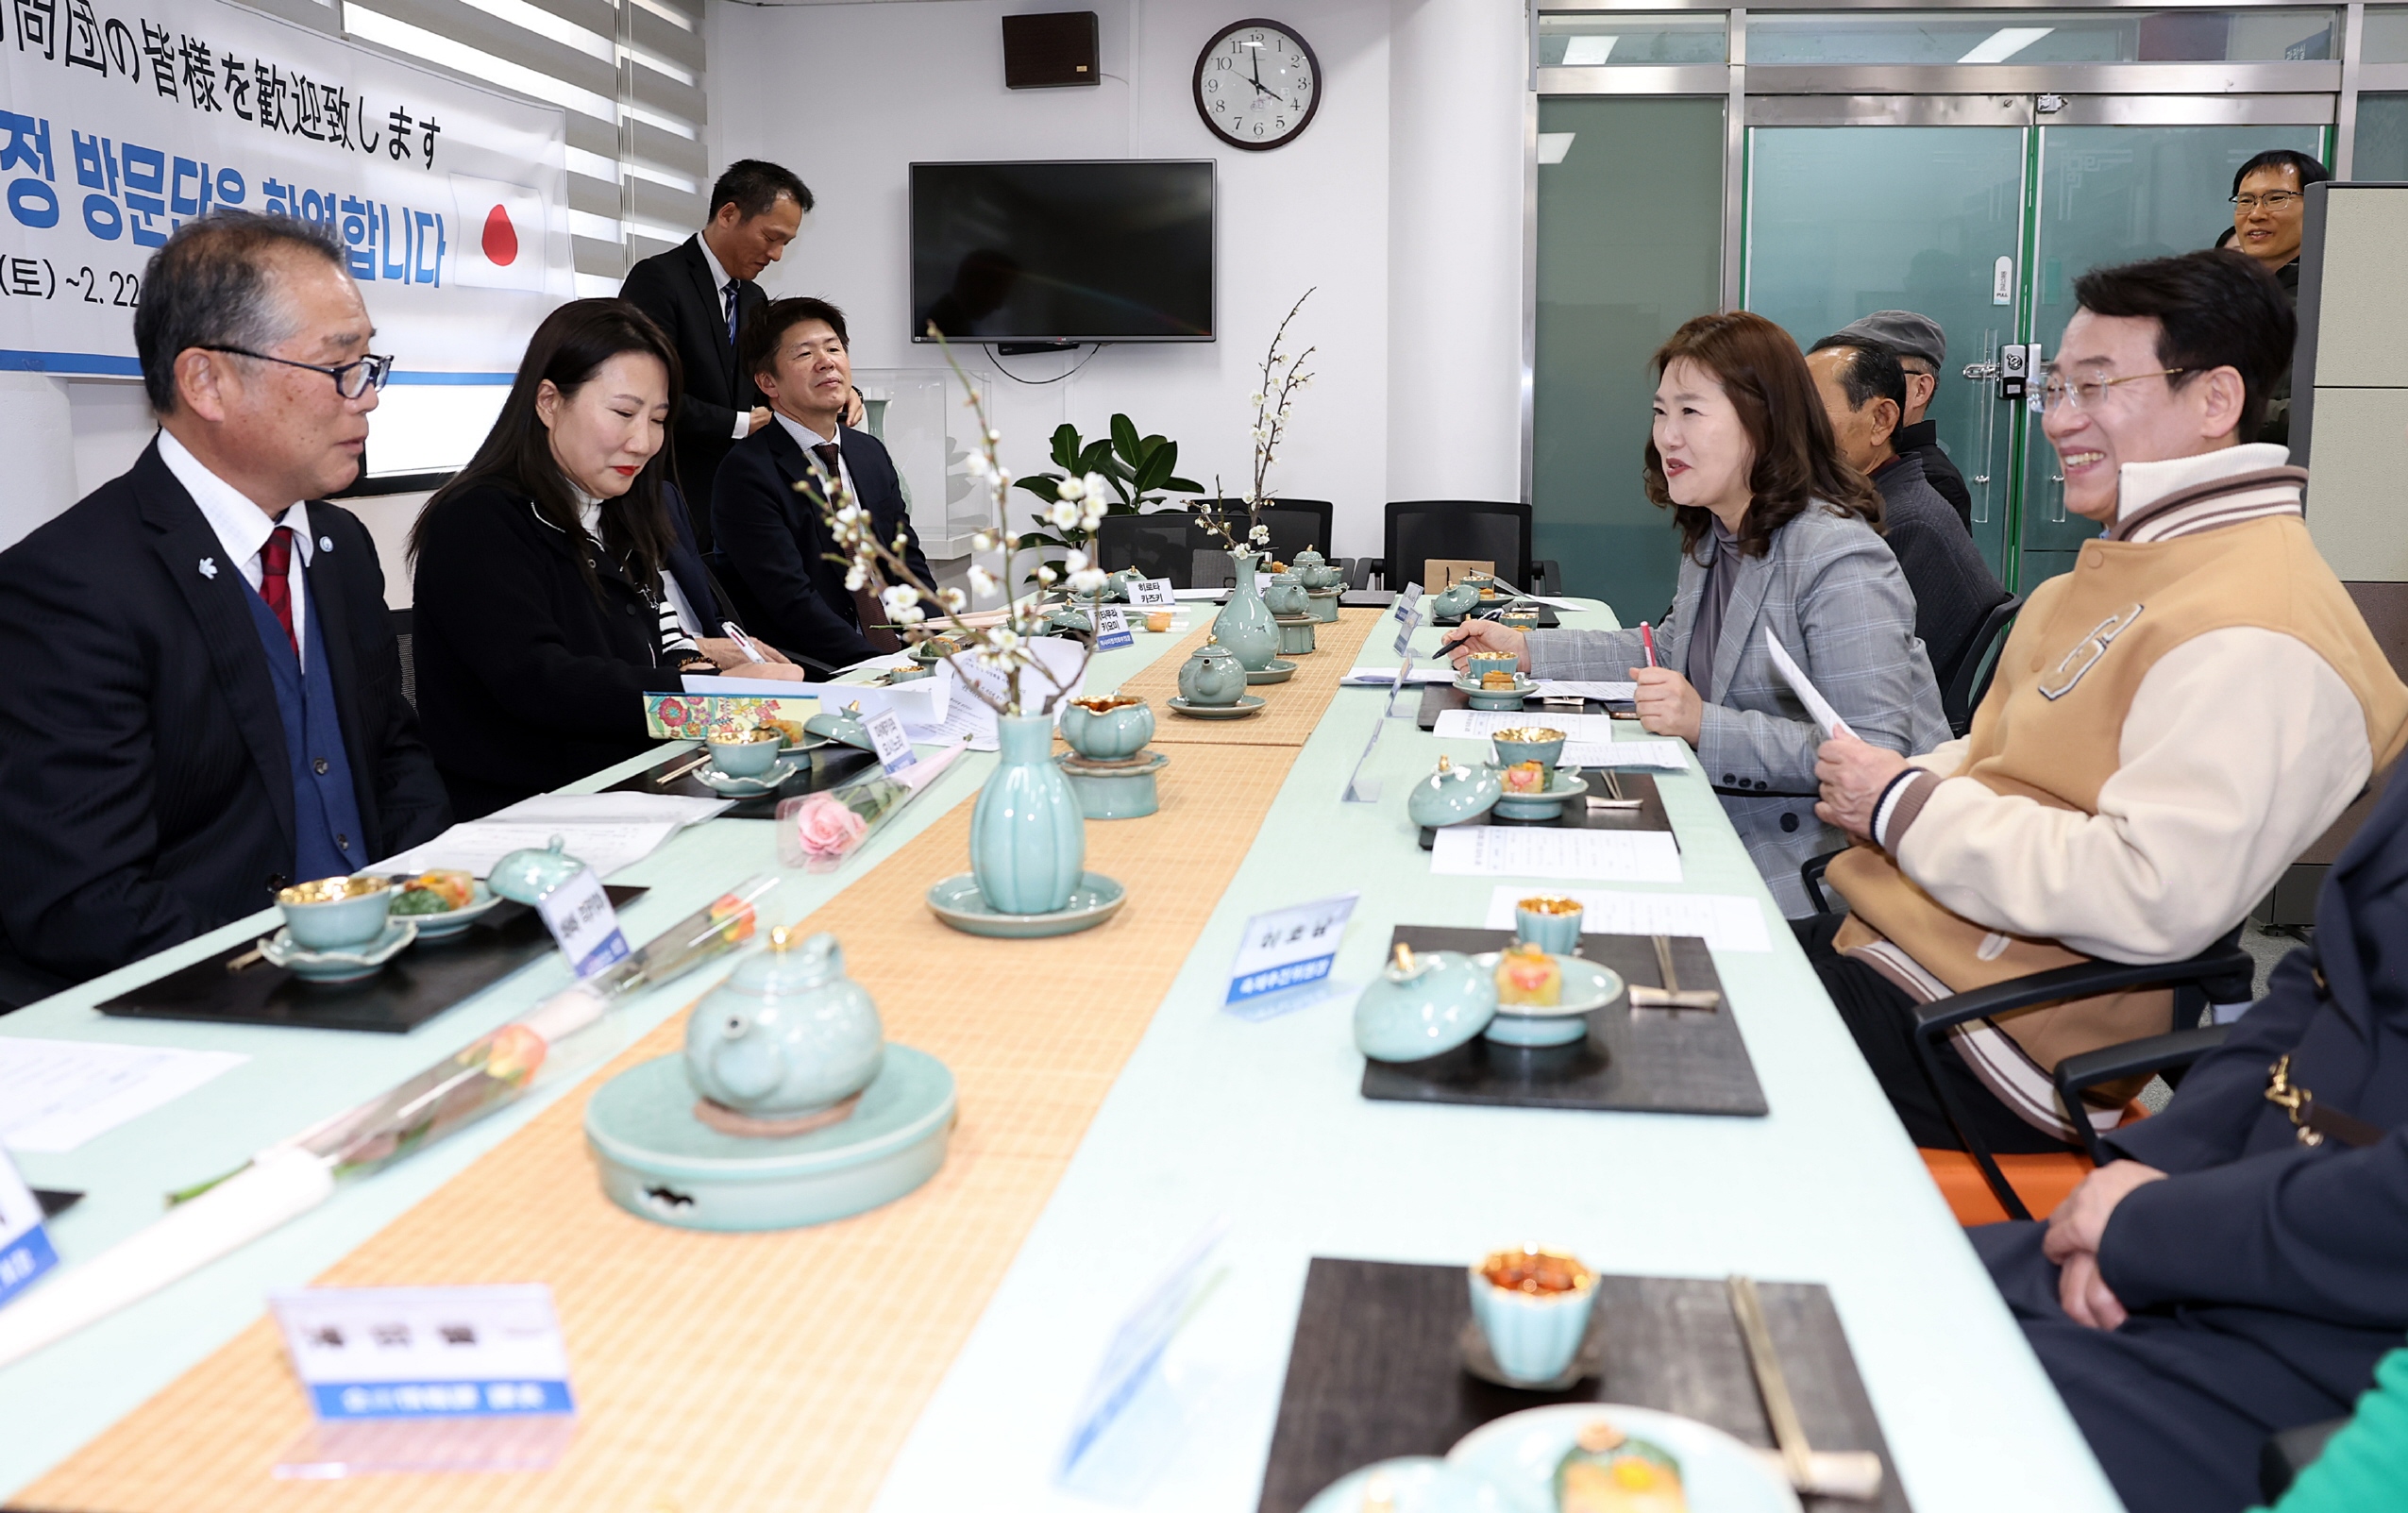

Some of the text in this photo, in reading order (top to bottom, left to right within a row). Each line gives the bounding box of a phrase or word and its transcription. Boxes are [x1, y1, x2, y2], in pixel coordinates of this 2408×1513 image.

[1231, 41, 1242, 54] 11
[1276, 39, 1282, 52] 1
[1216, 57, 1232, 71] 10
[1290, 55, 1300, 68] 2
[0, 0, 441, 170] 問団の皆様を歓迎致します
[1208, 79, 1218, 92] 9
[1297, 76, 1306, 90] 3
[1215, 99, 1225, 112] 8
[1289, 97, 1300, 110] 4
[1234, 116, 1242, 130] 7
[1275, 115, 1285, 128] 5
[1254, 122, 1263, 135] 6
[0, 254, 56, 299] (토)
[1137, 581, 1160, 592] 히로타
[1140, 593, 1163, 603] 카즈키
[1101, 620, 1120, 631] 키요미
